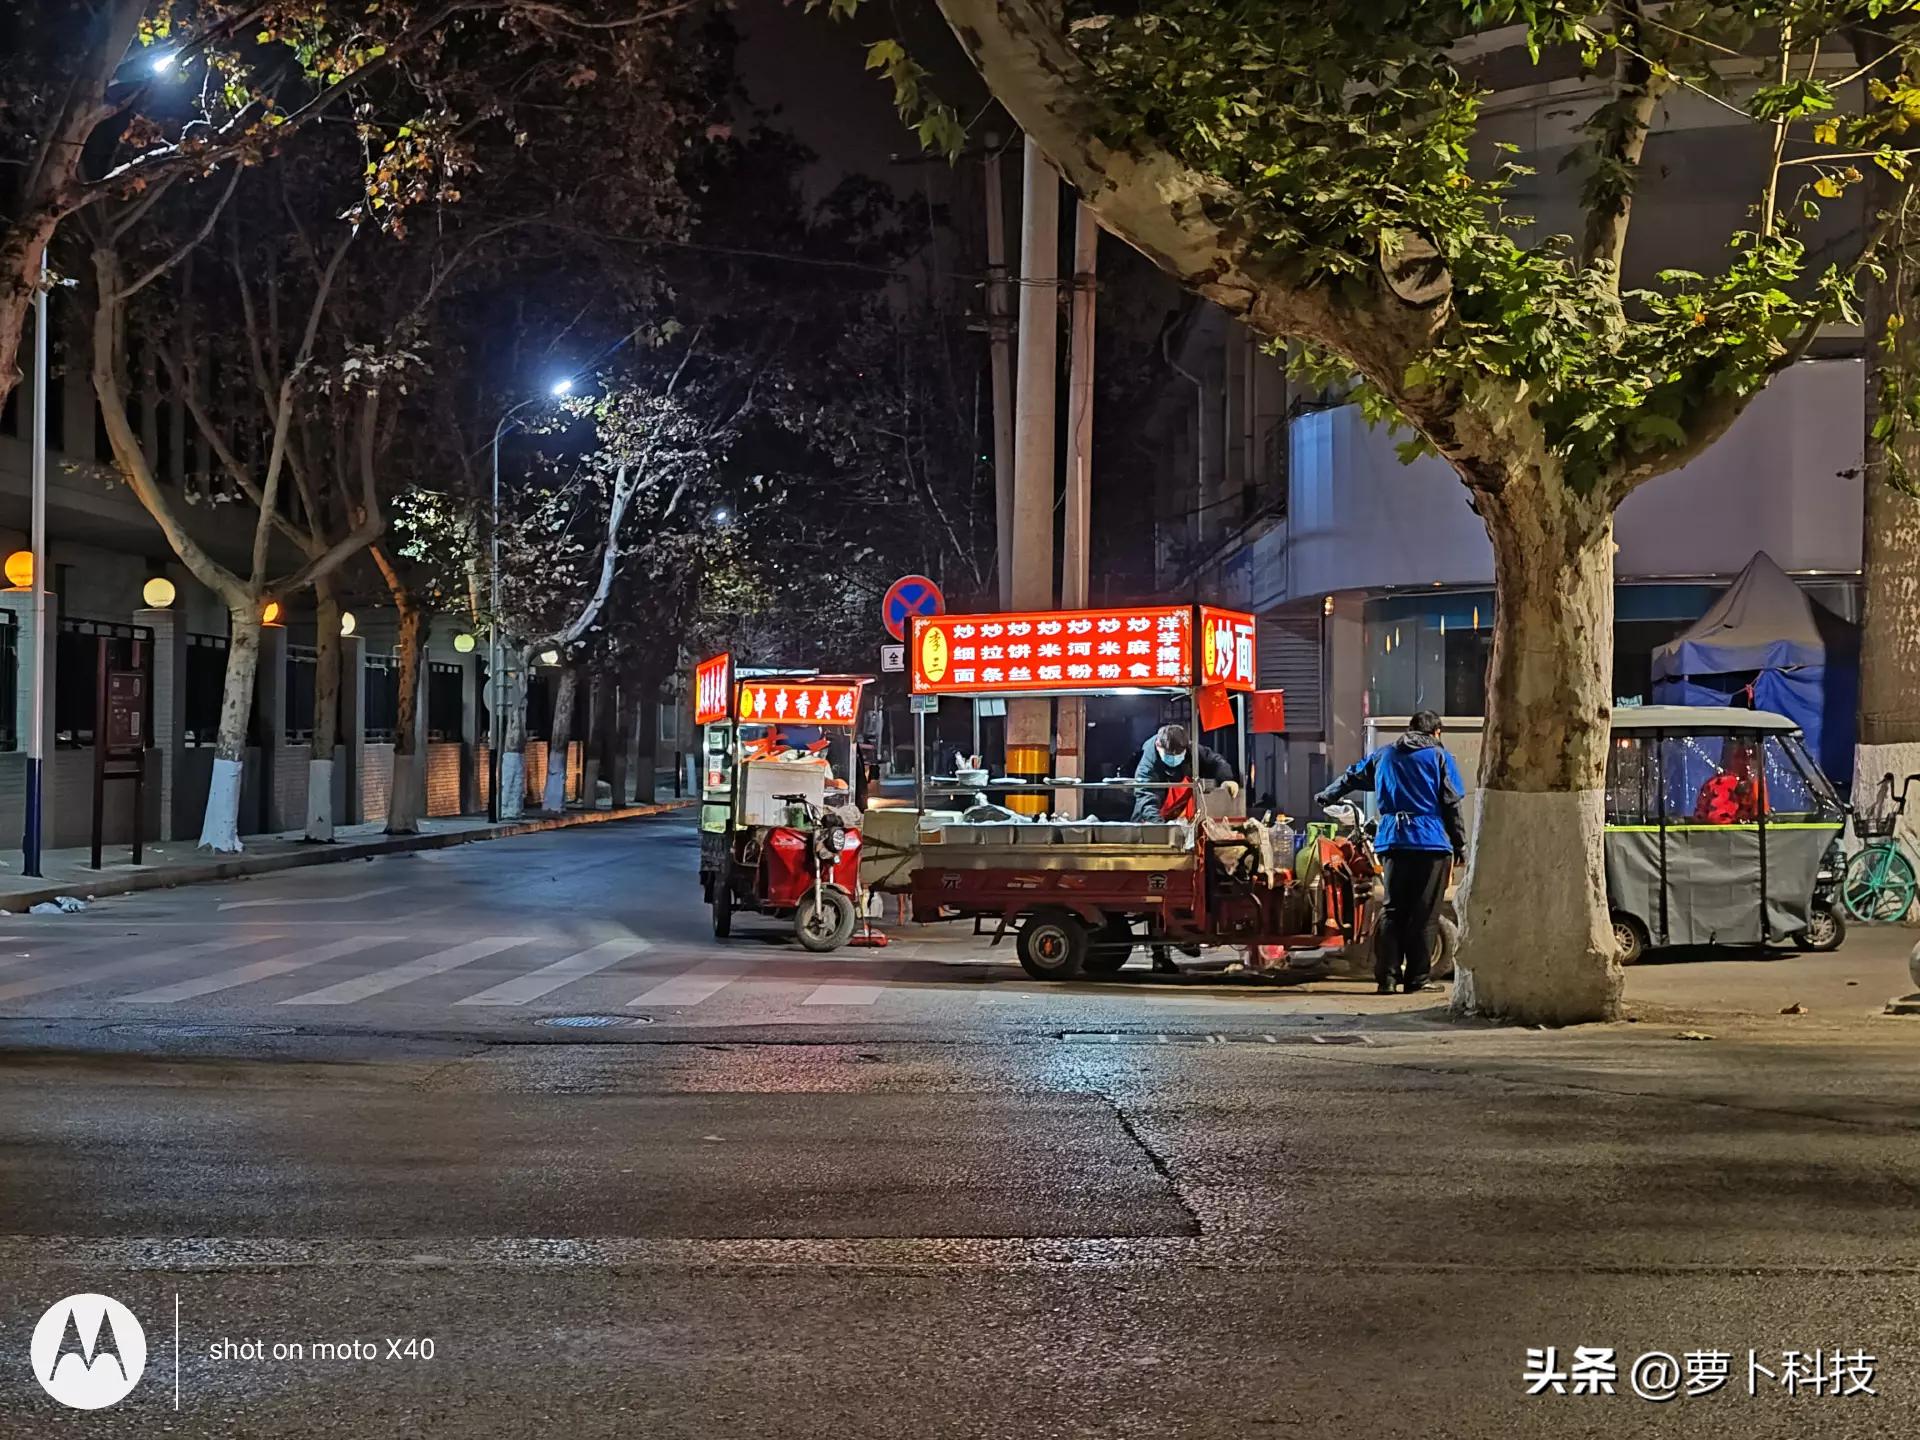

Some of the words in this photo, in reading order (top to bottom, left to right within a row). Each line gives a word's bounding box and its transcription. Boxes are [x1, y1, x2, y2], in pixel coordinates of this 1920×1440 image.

[889, 652, 904, 665] 全
[1215, 619, 1252, 683] 炒面
[754, 688, 853, 720] 串串香夹馍
